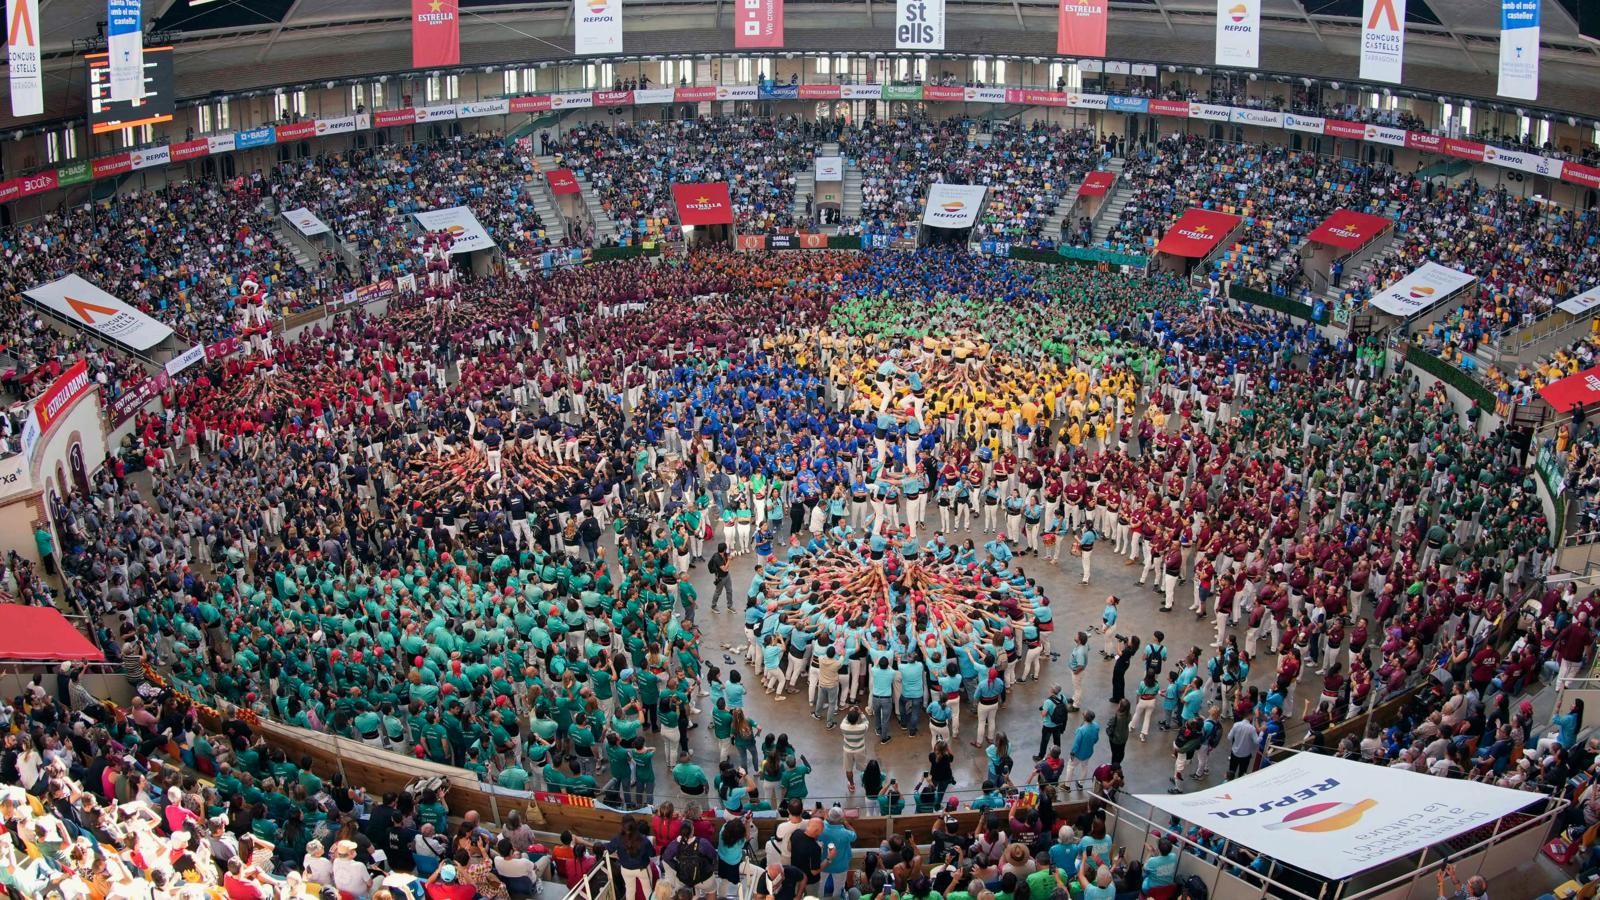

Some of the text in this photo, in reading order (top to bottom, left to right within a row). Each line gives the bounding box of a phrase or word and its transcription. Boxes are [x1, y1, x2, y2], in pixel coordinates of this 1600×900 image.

[906, 2, 926, 22] st
[1065, 5, 1102, 14] ESTRELLA
[418, 12, 454, 22] ESTRELLA
[898, 23, 934, 43] ells
[1366, 33, 1400, 43] CONCURS
[1366, 42, 1399, 51] CASTELLS
[10, 52, 36, 62] CONCURS
[472, 104, 504, 113] CaixaBank
[1246, 114, 1277, 123] CaixaBank
[330, 121, 354, 129] REPSOL
[250, 130, 270, 140] BASF
[1380, 133, 1404, 141] REPSOL
[146, 152, 168, 161] REPSOL
[1500, 155, 1522, 164] REPSOL
[1178, 229, 1214, 240] ESTRELLA
[1328, 227, 1361, 238] ESTRELLA
[1392, 294, 1424, 306] REPSOL
[48, 370, 89, 418] ESTRELLA DAMM
[1208, 778, 1341, 818] REPSOL
[1355, 814, 1424, 840] cultura
